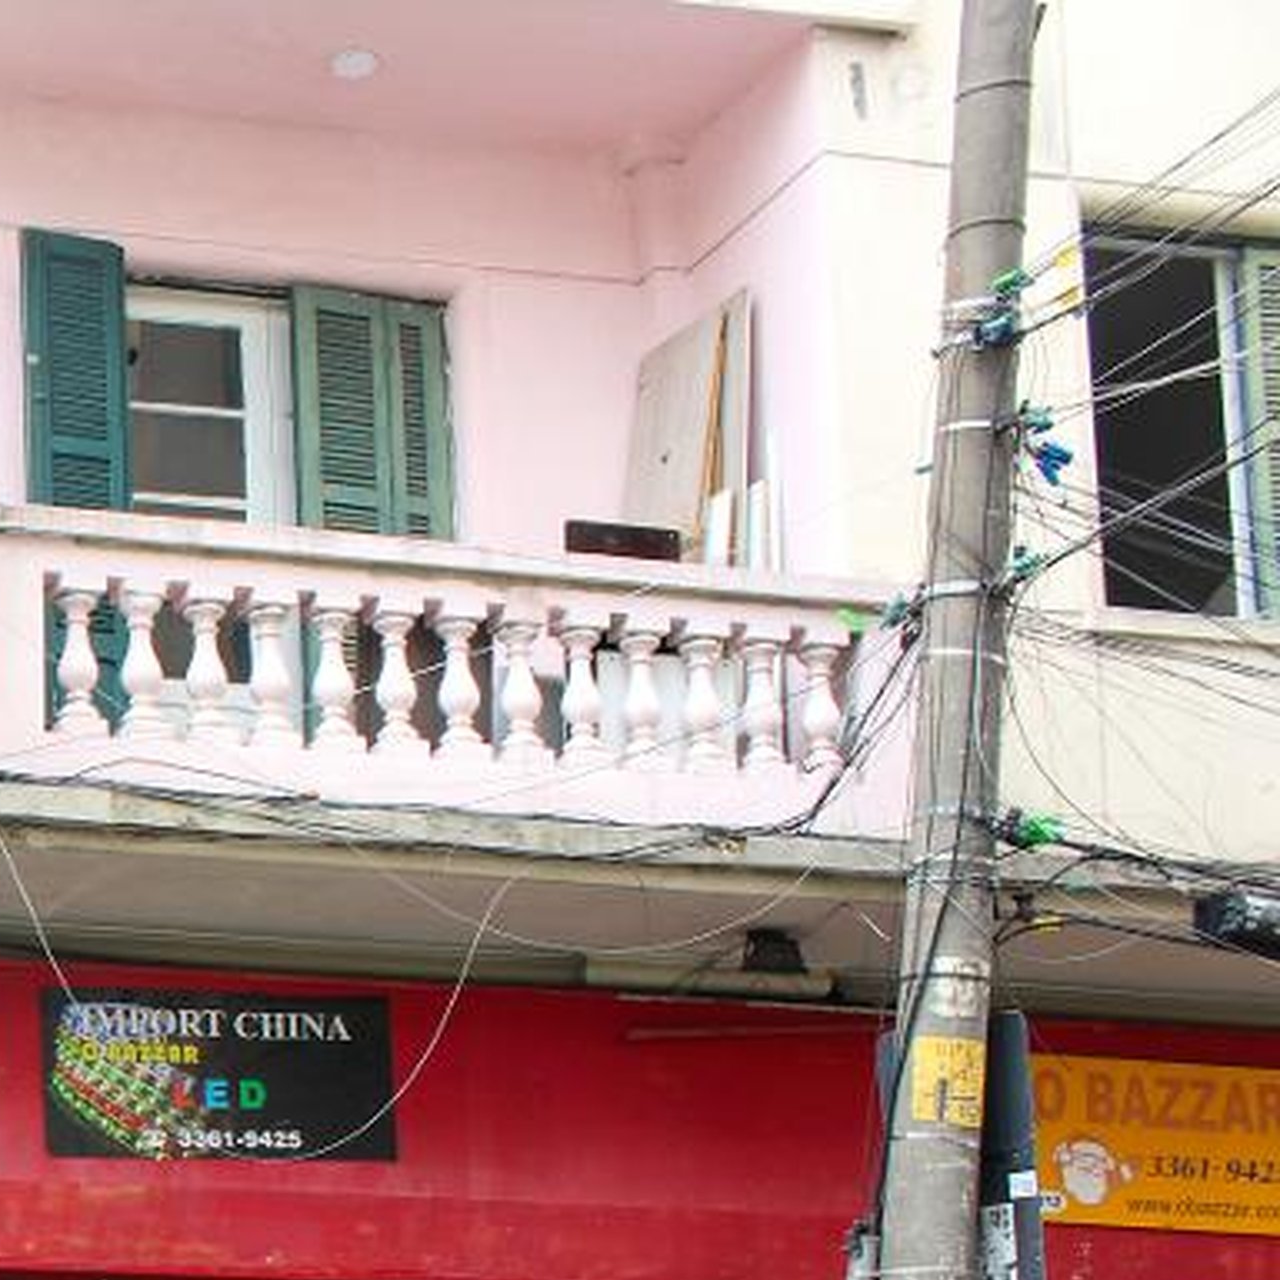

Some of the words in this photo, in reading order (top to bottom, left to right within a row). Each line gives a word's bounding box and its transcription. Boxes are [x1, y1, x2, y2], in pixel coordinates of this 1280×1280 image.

[79, 1001, 225, 1039] IMPORT
[233, 1010, 352, 1042] CHINA
[171, 1076, 267, 1110] LED
[177, 1128, 303, 1151] 3361-9425
